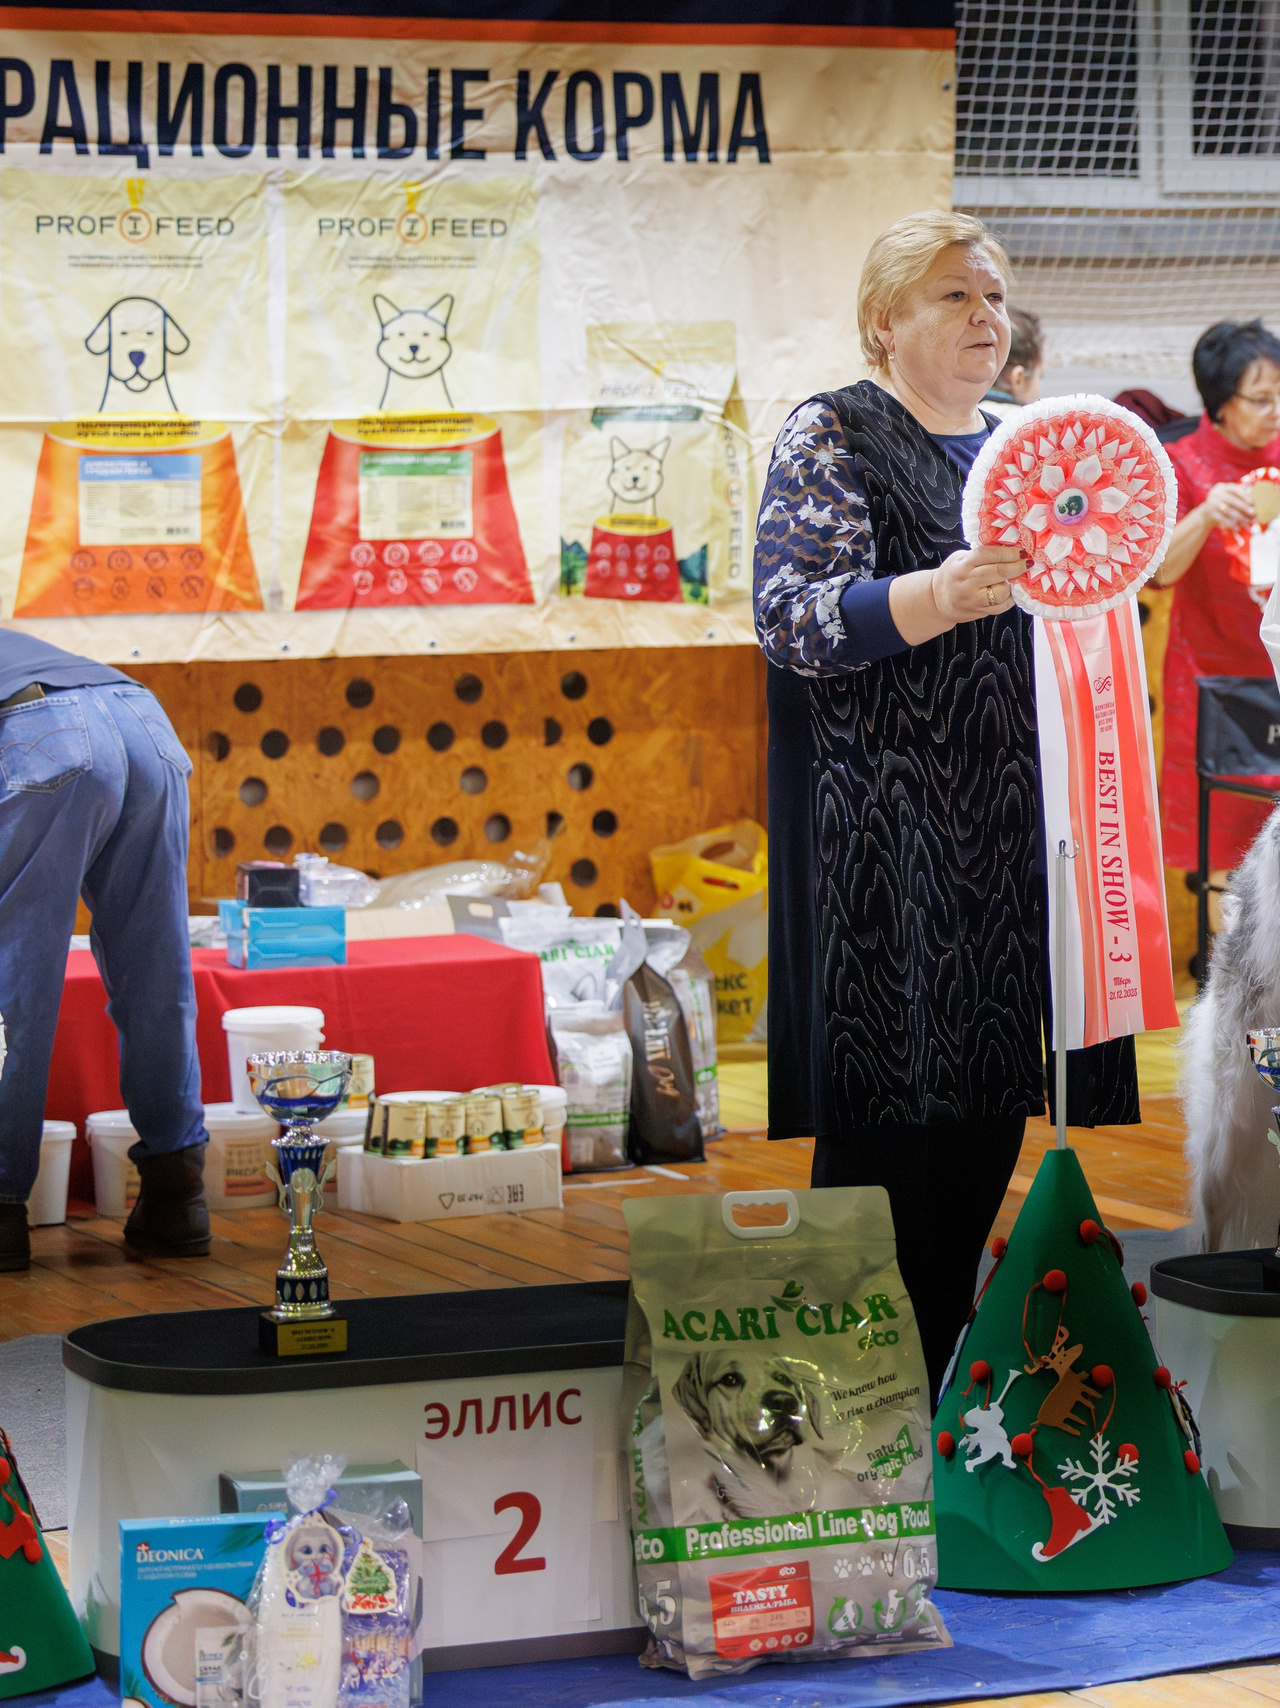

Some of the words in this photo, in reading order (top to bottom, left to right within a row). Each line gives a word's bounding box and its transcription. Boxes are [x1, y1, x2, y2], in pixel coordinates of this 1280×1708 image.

[515, 69, 772, 164] КОРМА
[1099, 750, 1118, 814] BEST
[1100, 820, 1121, 849] IN
[1101, 855, 1130, 931] SHOW
[1109, 951, 1132, 963] 3
[1109, 988, 1138, 1000] 21.12.2025
[662, 1306, 781, 1342] ACARI
[796, 1293, 899, 1336] CIAR
[858, 1329, 899, 1350] eco
[831, 1390, 848, 1402] We
[849, 1380, 876, 1398] know
[877, 1372, 898, 1386] how
[847, 1406, 864, 1419] rise
[866, 1404, 873, 1412] a
[874, 1386, 920, 1408] champion
[424, 1387, 582, 1440] ЭЛЛИС
[857, 1458, 902, 1482] organic
[903, 1444, 923, 1467] food
[867, 1435, 909, 1461] natural
[494, 1491, 546, 1576] 2
[685, 1516, 813, 1552] Professional
[817, 1511, 858, 1538] Line
[861, 1508, 898, 1536] Dog
[900, 1503, 930, 1529] Food
[136, 1549, 203, 1563] DEONICA
[778, 1566, 797, 1576] eco
[733, 1584, 789, 1605] TASTY
